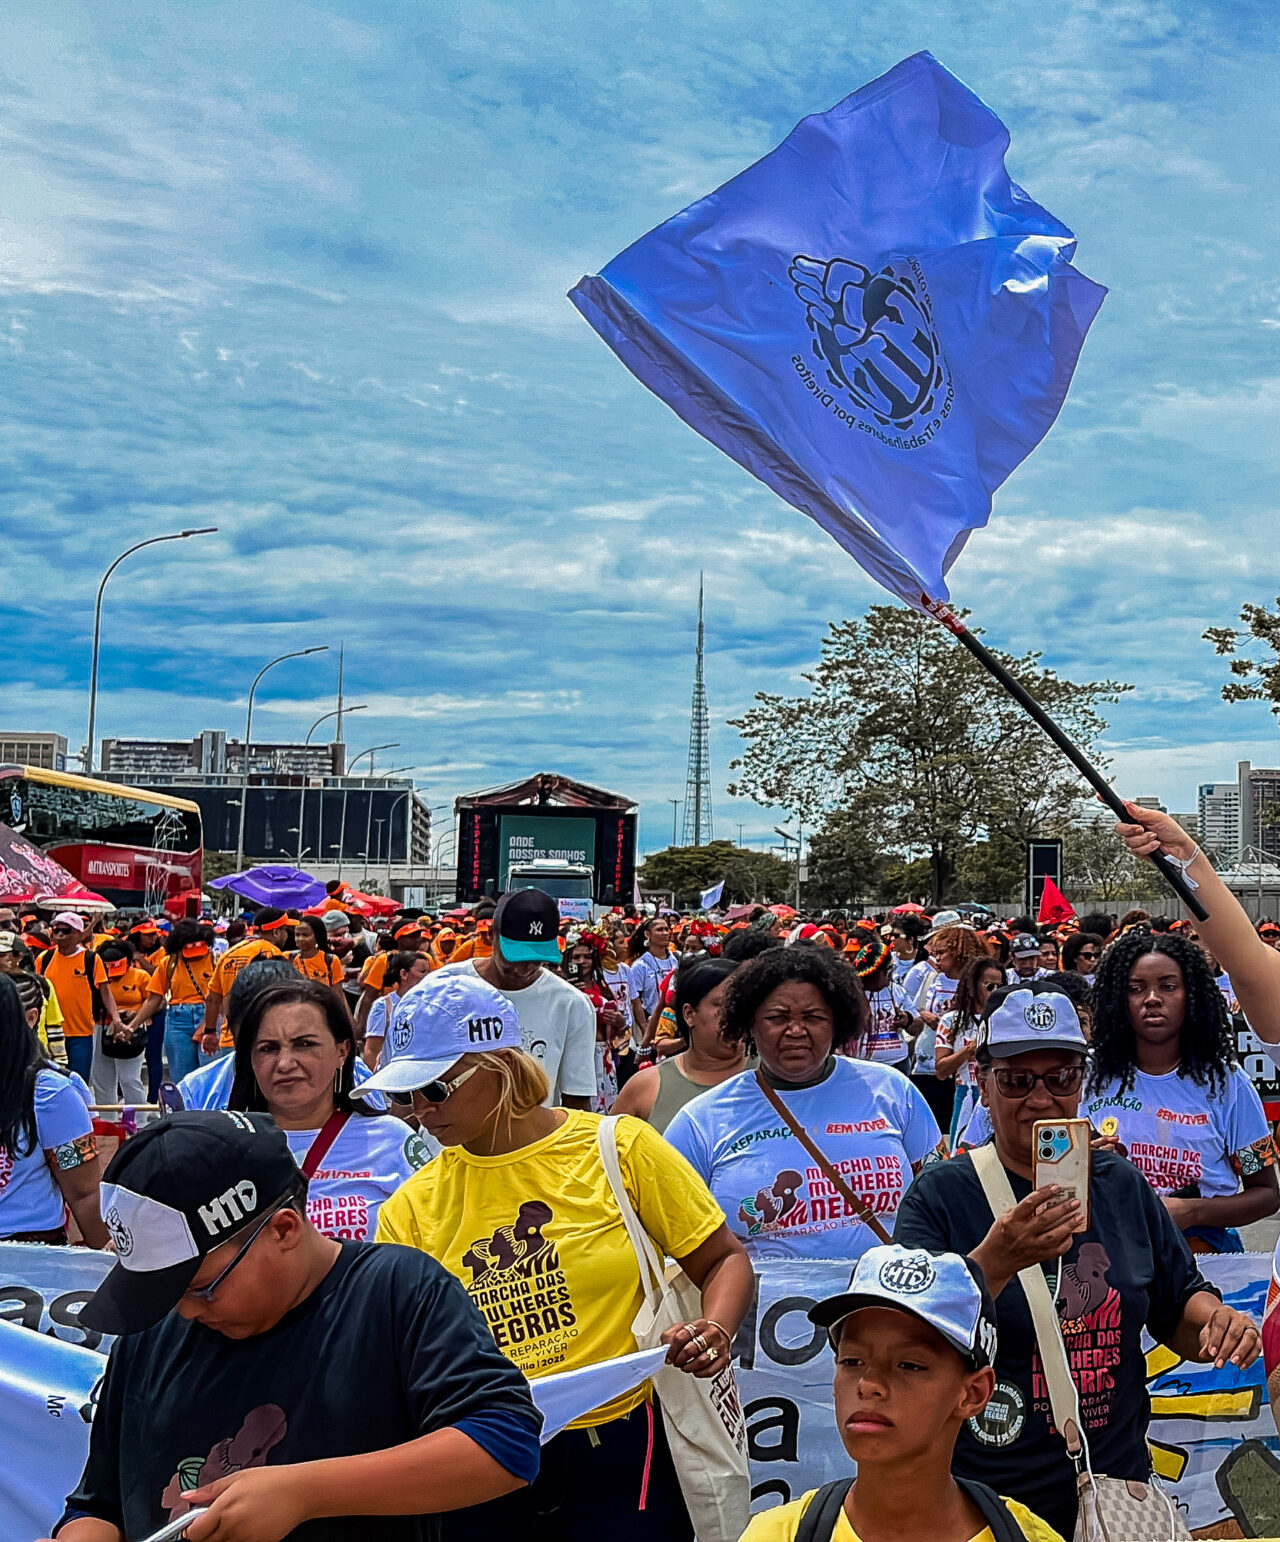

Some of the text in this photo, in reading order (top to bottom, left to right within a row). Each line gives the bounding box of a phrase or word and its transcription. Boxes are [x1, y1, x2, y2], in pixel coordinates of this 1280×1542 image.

[509, 836, 534, 847] ONDE
[509, 849, 546, 860] NOSSOS
[467, 1016, 504, 1043] MTD
[1088, 1097, 1209, 1126] REPARAÇÃO BEM VIVER
[826, 1122, 853, 1134] BEM
[853, 1118, 888, 1133] VIVER
[1131, 1143, 1178, 1161] MARCHA
[876, 1156, 900, 1170] DAS
[1131, 1156, 1202, 1179] MULHERES
[808, 1172, 903, 1198] MUHERES
[198, 1180, 258, 1236] MTD
[338, 1196, 367, 1208] DAS
[311, 1208, 368, 1229] HERES
[773, 1221, 838, 1240] REPARAÇÃO
[535, 1270, 566, 1291] DAS
[887, 1267, 925, 1287] MTD
[481, 1286, 571, 1323] ULHERES
[492, 1302, 576, 1347] EGRAS
[510, 1329, 579, 1358] REPARAÇÃO
[1097, 1330, 1121, 1346] DAS
[542, 1354, 565, 1367] 2025
[1034, 1402, 1049, 1412] PO
[1082, 1404, 1110, 1418] VIVER
